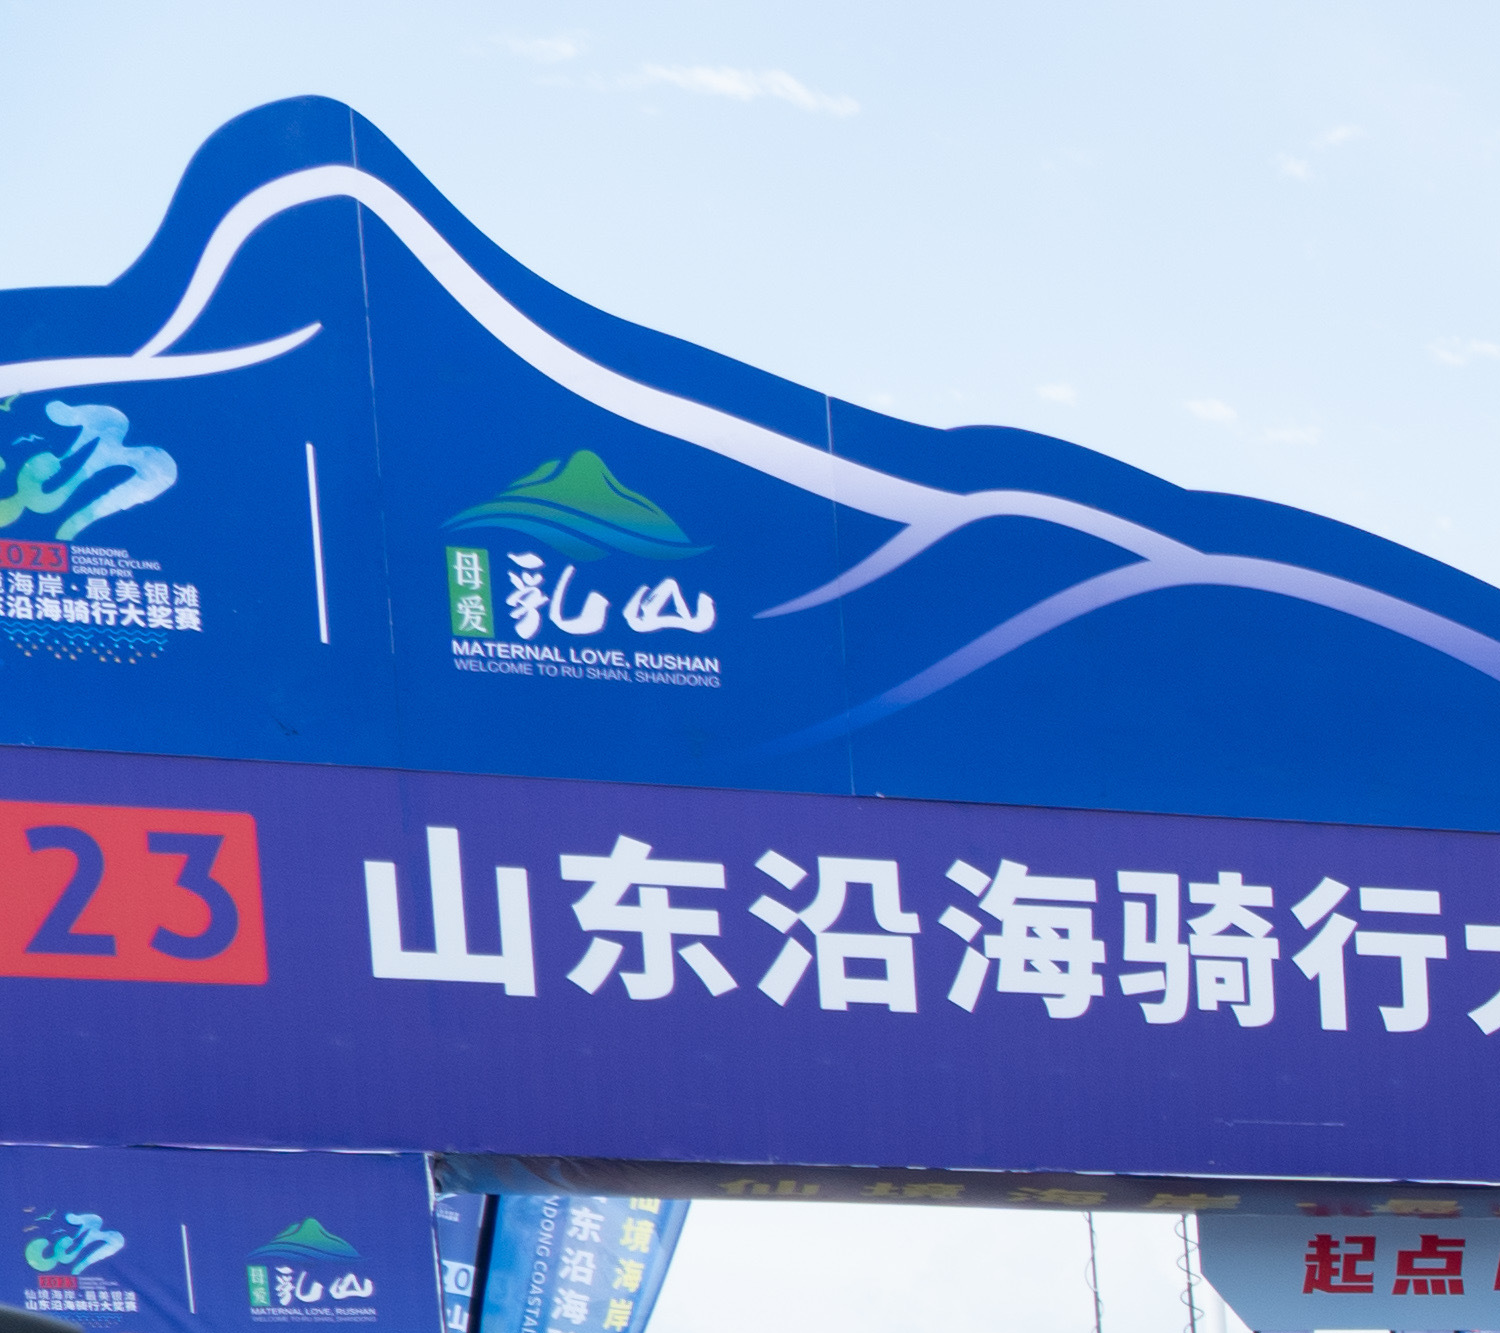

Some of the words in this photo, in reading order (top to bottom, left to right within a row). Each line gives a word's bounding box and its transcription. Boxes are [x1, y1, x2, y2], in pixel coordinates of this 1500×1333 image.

[70, 545, 129, 559] SHANDONG
[71, 556, 116, 568] COASTAL
[118, 560, 162, 571] CYCLING
[0, 571, 201, 608] 海岸·最美银滩
[72, 566, 108, 577] GRAND
[110, 569, 134, 578] PRIX
[453, 550, 488, 634] 母爱
[505, 552, 716, 640] 乳山
[0, 596, 204, 633] 沿海骑行大奖赛
[451, 639, 566, 664] MATERNAL
[634, 652, 721, 674] RUSHAN
[454, 658, 534, 677] WELCOME
[538, 664, 558, 678] TO
[563, 665, 584, 680] RU
[635, 671, 721, 689] SHANDONG
[536, 1195, 560, 1257] NDONG
[274, 1266, 374, 1306] 乳山
